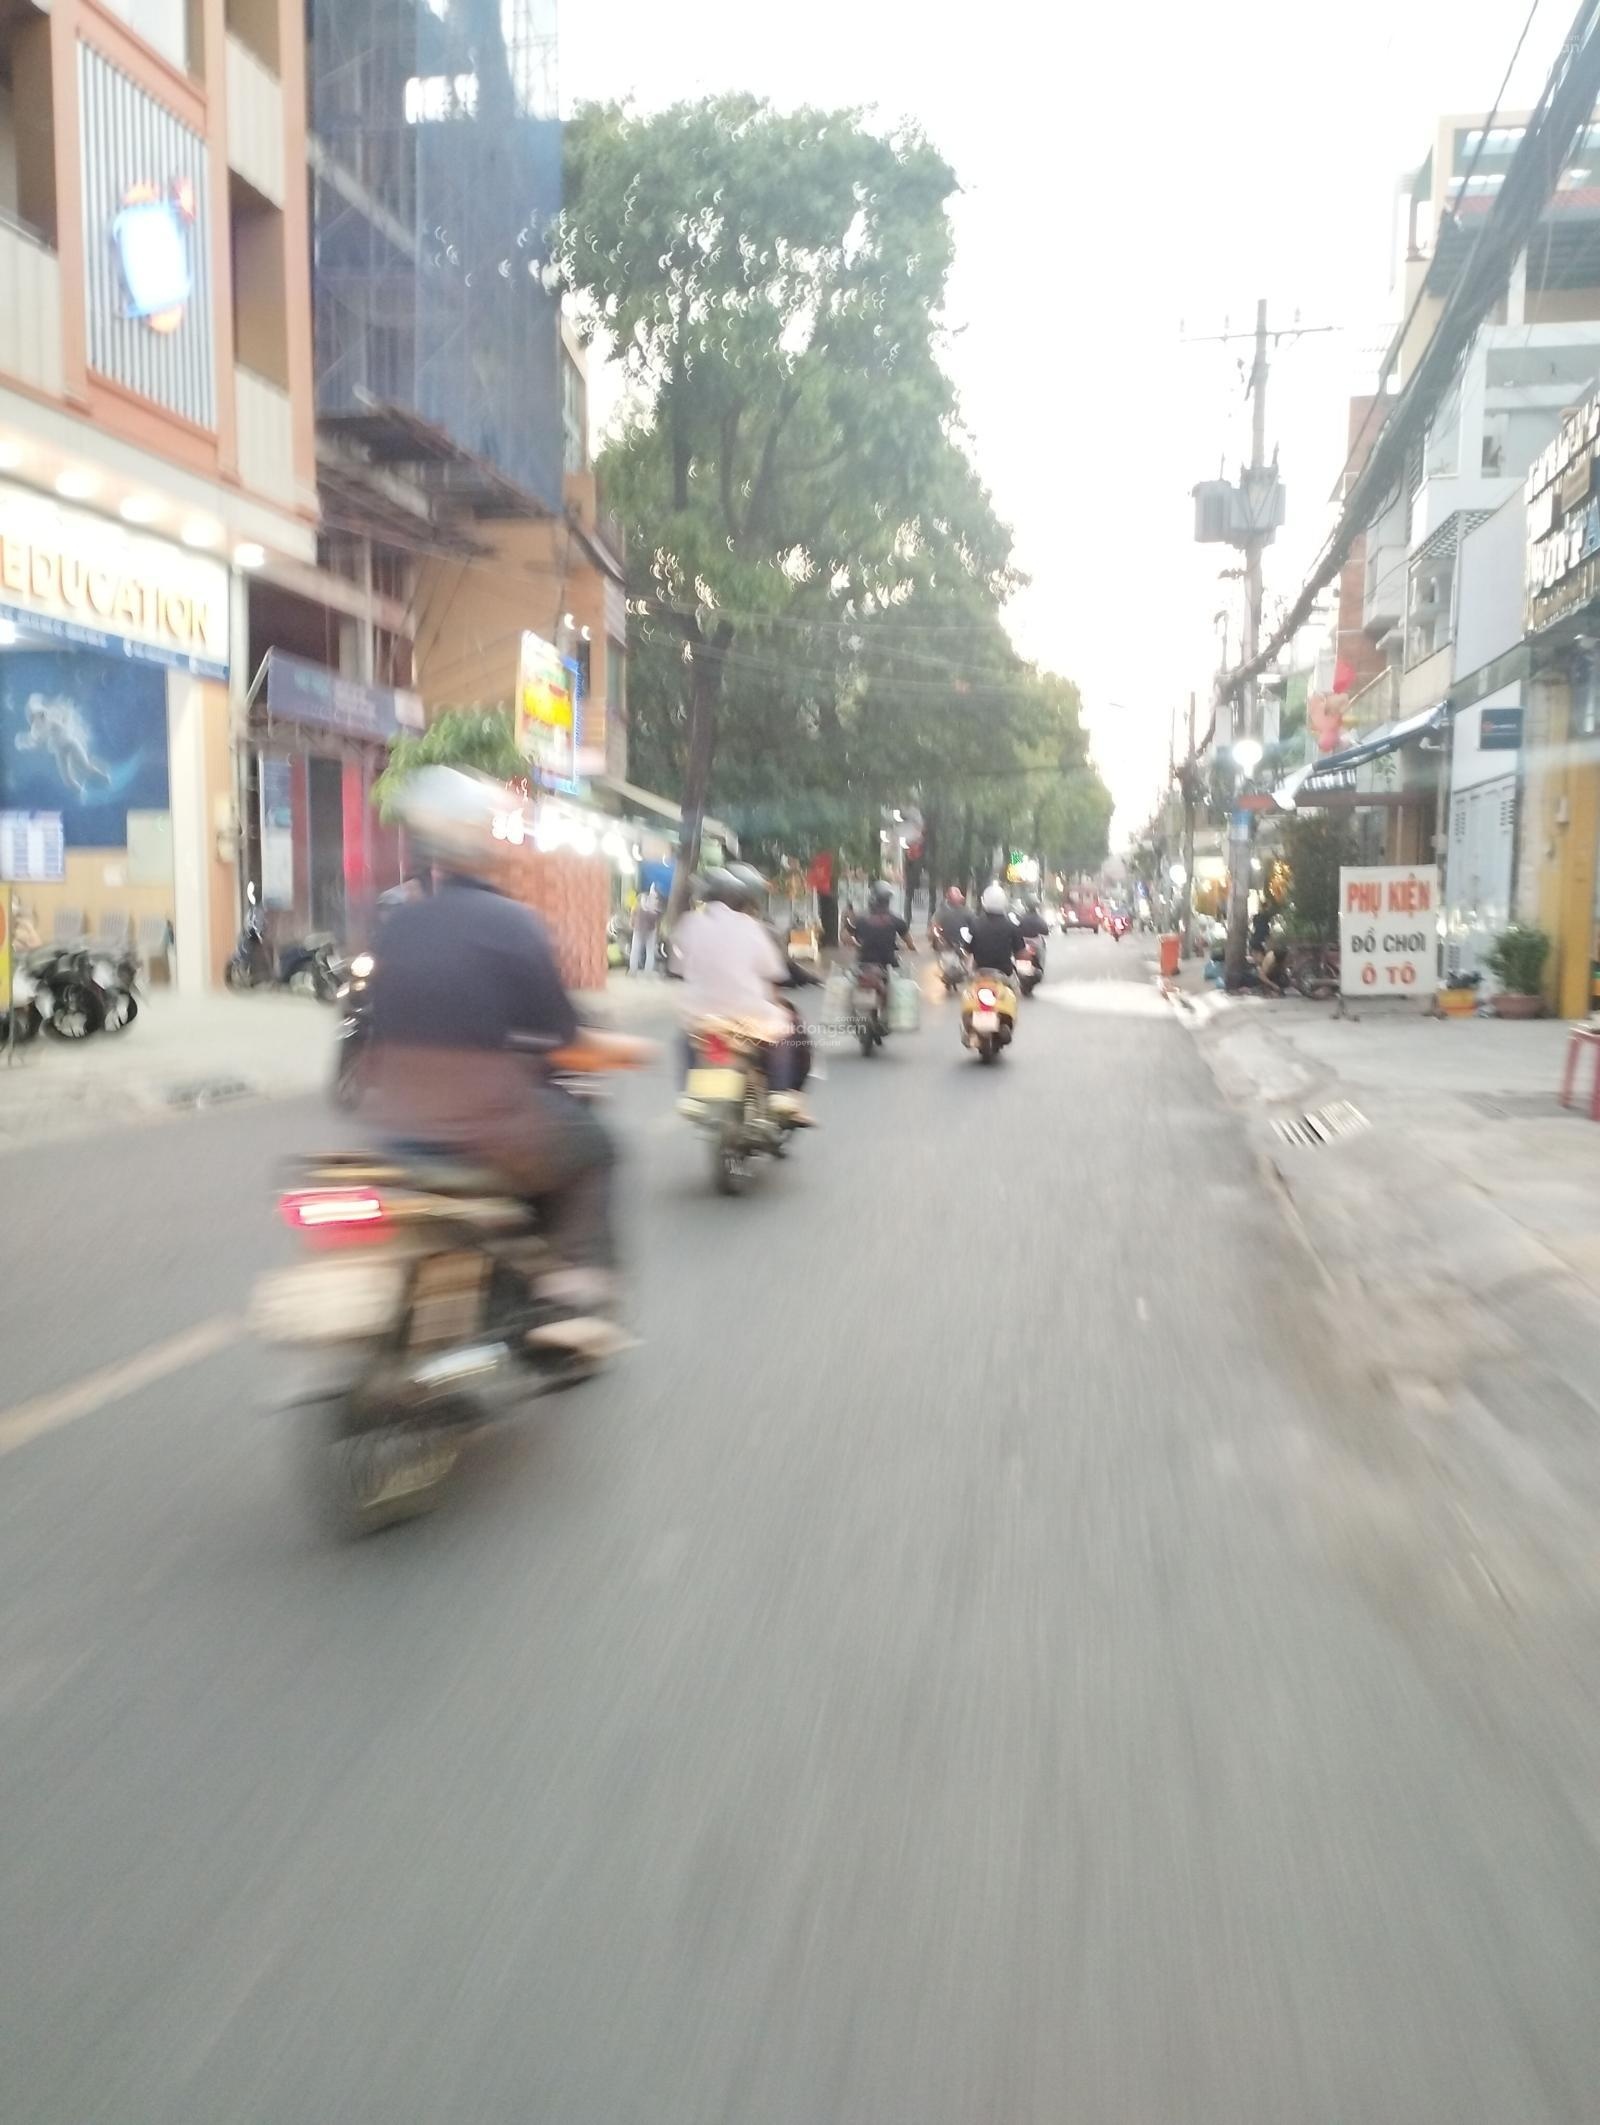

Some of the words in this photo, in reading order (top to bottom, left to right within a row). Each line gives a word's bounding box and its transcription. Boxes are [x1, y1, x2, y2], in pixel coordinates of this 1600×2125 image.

[0, 534, 207, 645] EDUCATION
[1347, 882, 1382, 918] PHỤ
[1388, 873, 1431, 917] KIỆN
[1351, 927, 1376, 953] ĐỒ
[1383, 931, 1426, 953] CHƠI
[1362, 962, 1377, 985] Ô
[1385, 961, 1416, 985] TÔ
